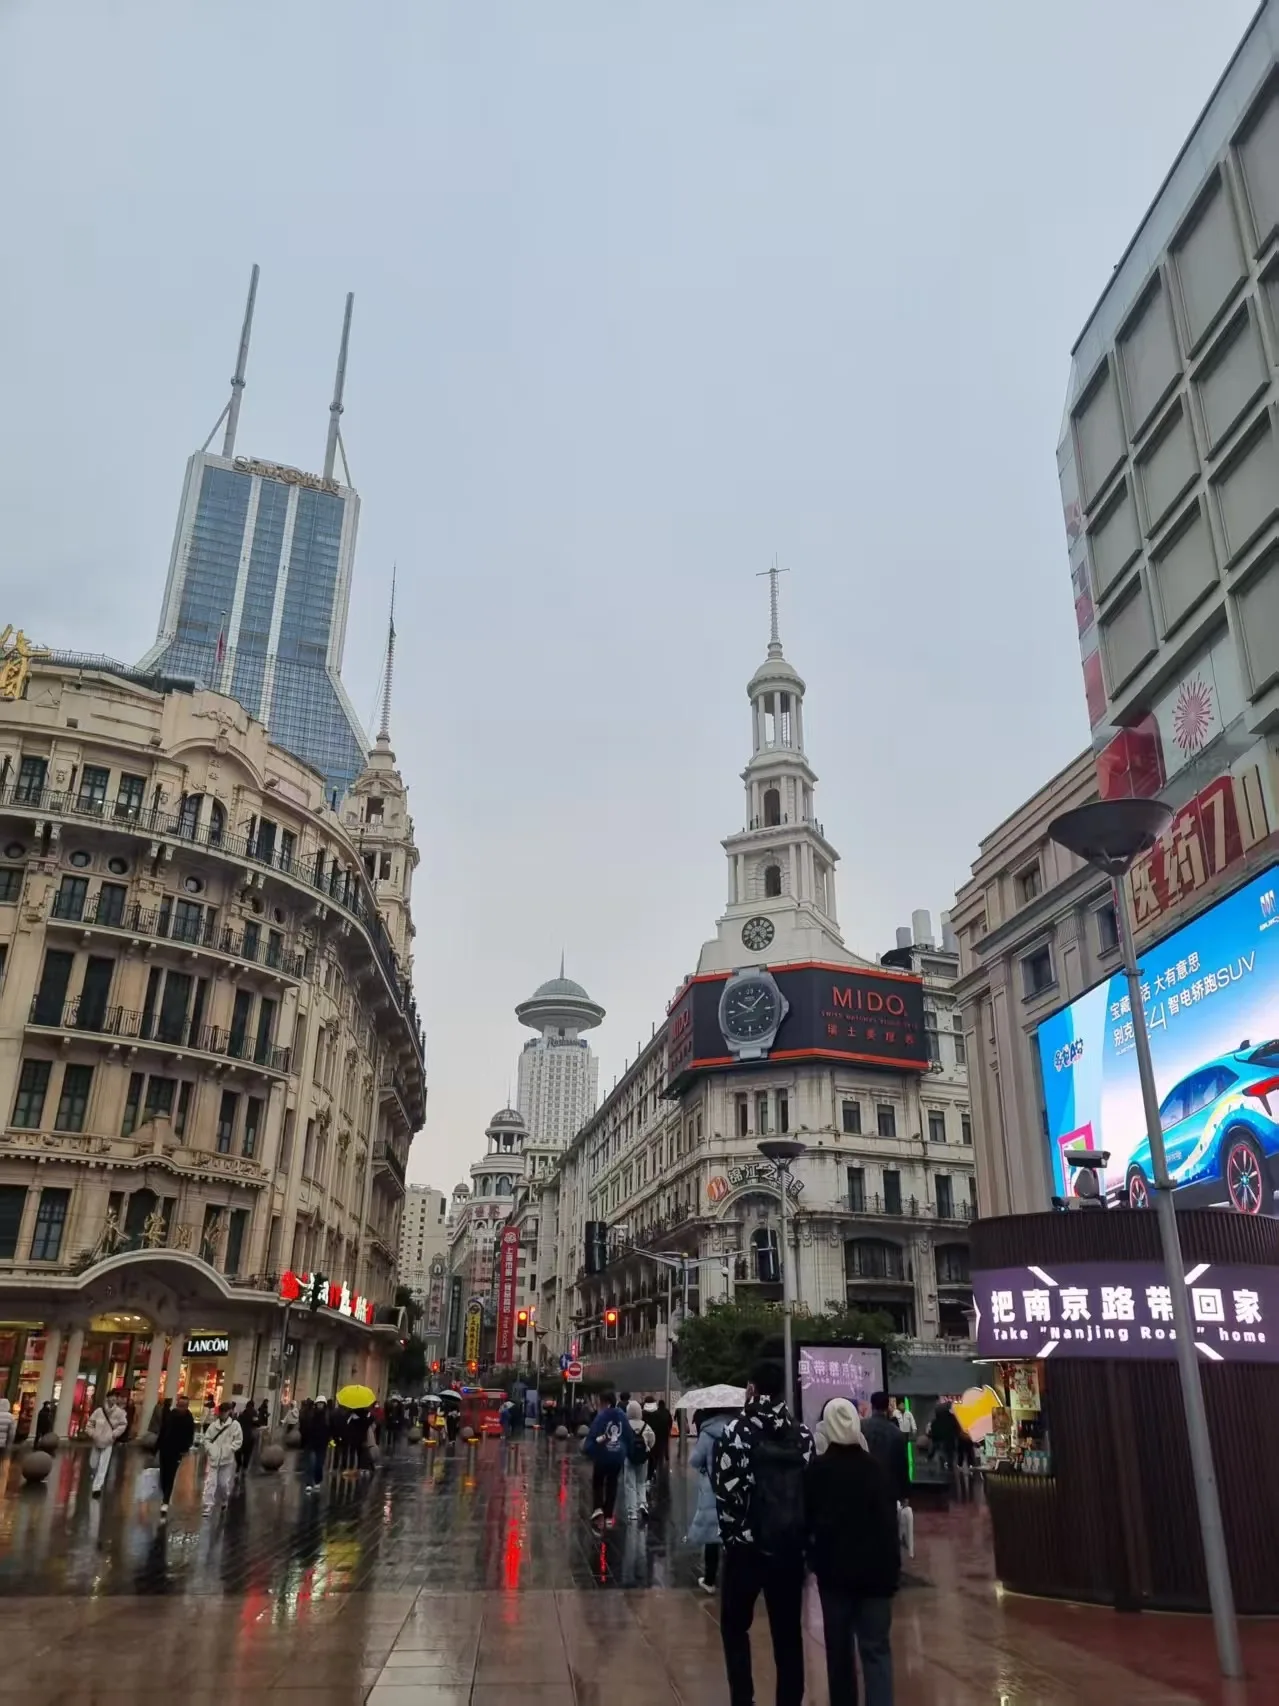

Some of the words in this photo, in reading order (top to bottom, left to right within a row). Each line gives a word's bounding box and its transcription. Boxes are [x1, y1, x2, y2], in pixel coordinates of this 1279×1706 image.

[832, 986, 905, 1016] MIDO
[1110, 981, 1151, 1021] 宝藏活
[1153, 951, 1200, 996] 大有意思
[990, 1285, 1263, 1324] 把南京路带回家
[993, 1327, 1029, 1341] Take
[1040, 1325, 1129, 1342] "Nanjing
[1219, 1327, 1266, 1343] home
